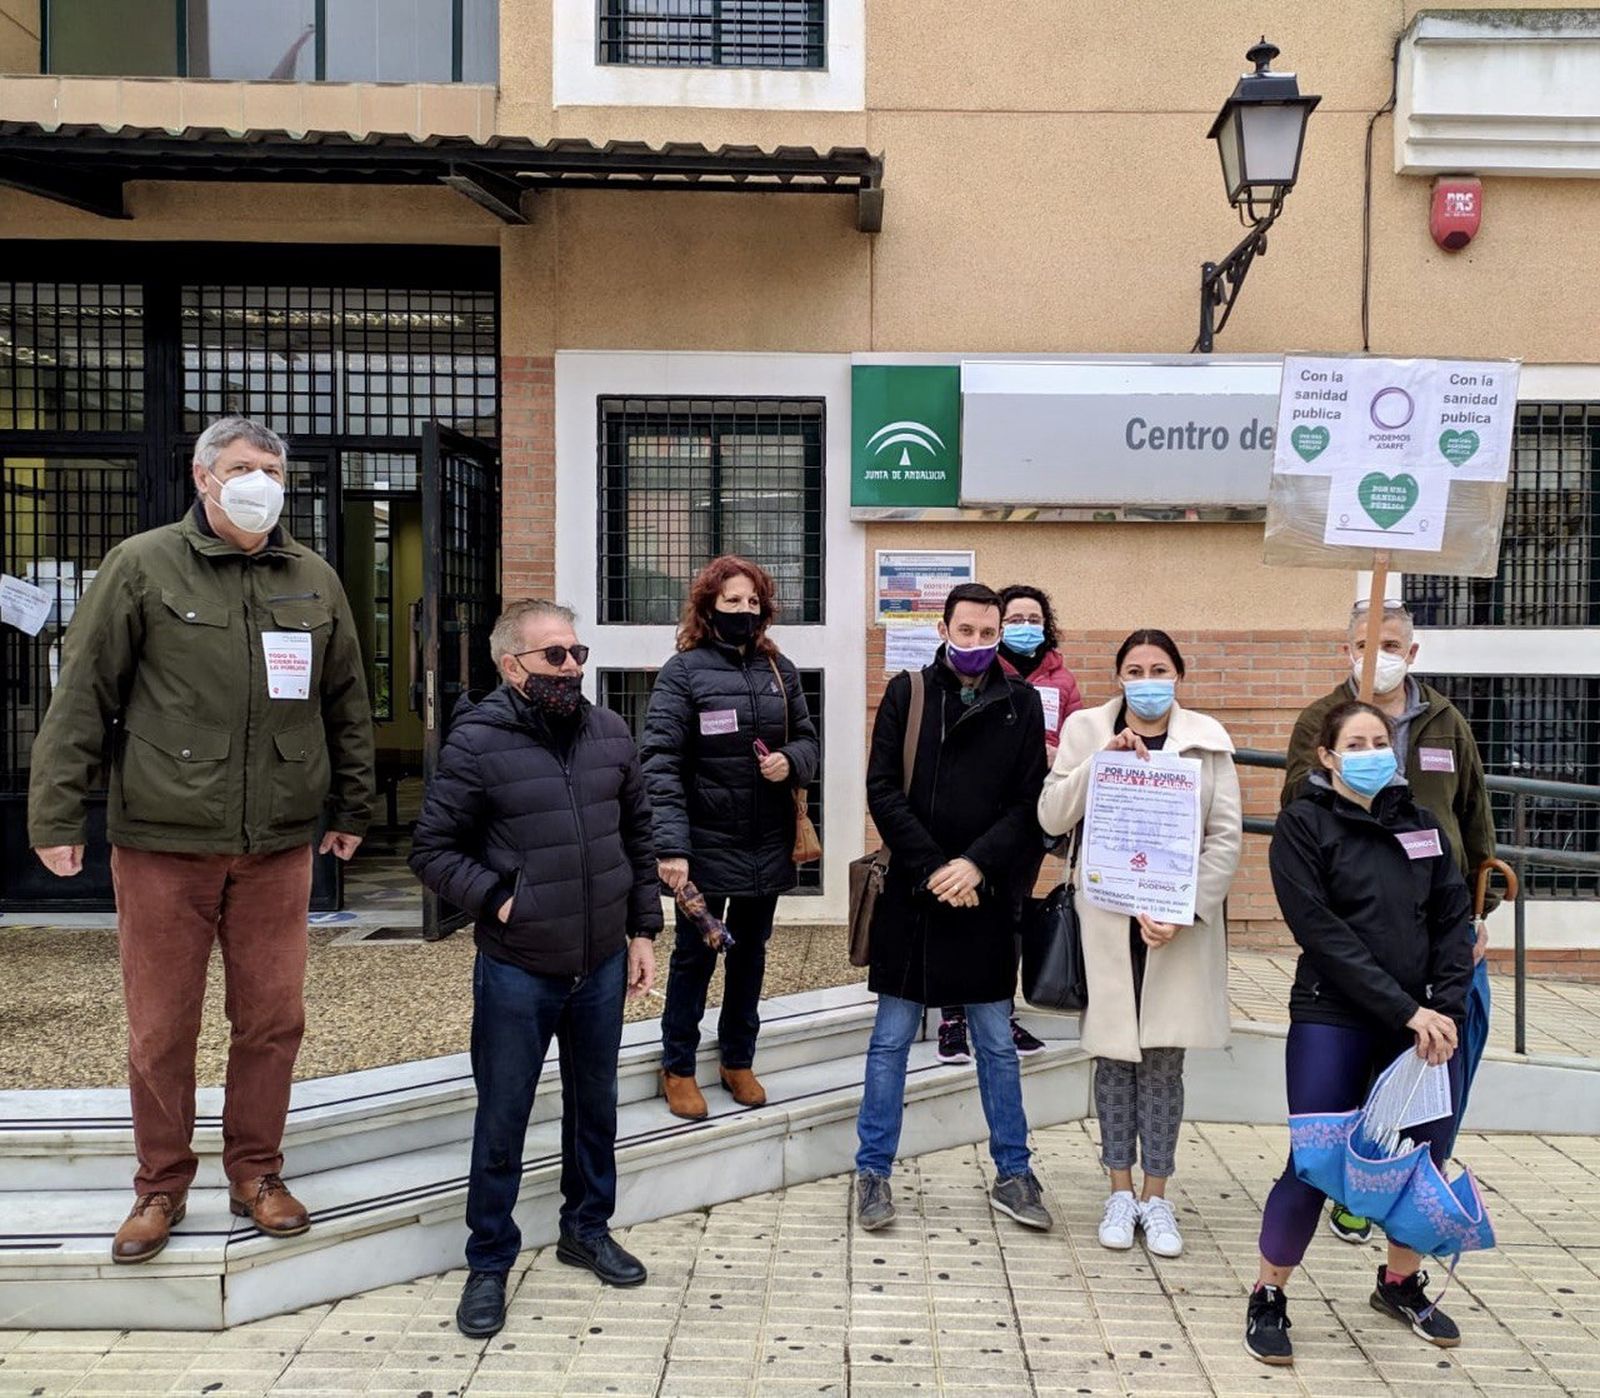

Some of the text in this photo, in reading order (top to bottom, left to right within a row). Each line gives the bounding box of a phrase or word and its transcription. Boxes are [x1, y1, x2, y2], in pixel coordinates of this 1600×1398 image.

[1300, 369, 1344, 383] Con la
[1449, 373, 1494, 387] Con la
[1294, 389, 1349, 402] sanidad
[1443, 393, 1499, 406] sanidad
[1292, 407, 1342, 421] publica
[1440, 411, 1492, 425] publica
[1125, 417, 1276, 450] Centro de
[1368, 434, 1411, 442] PODEMOS
[864, 470, 889, 480] JUNTA
[891, 470, 902, 480] DE
[1105, 767, 1187, 782] POR UNA SANIDAD
